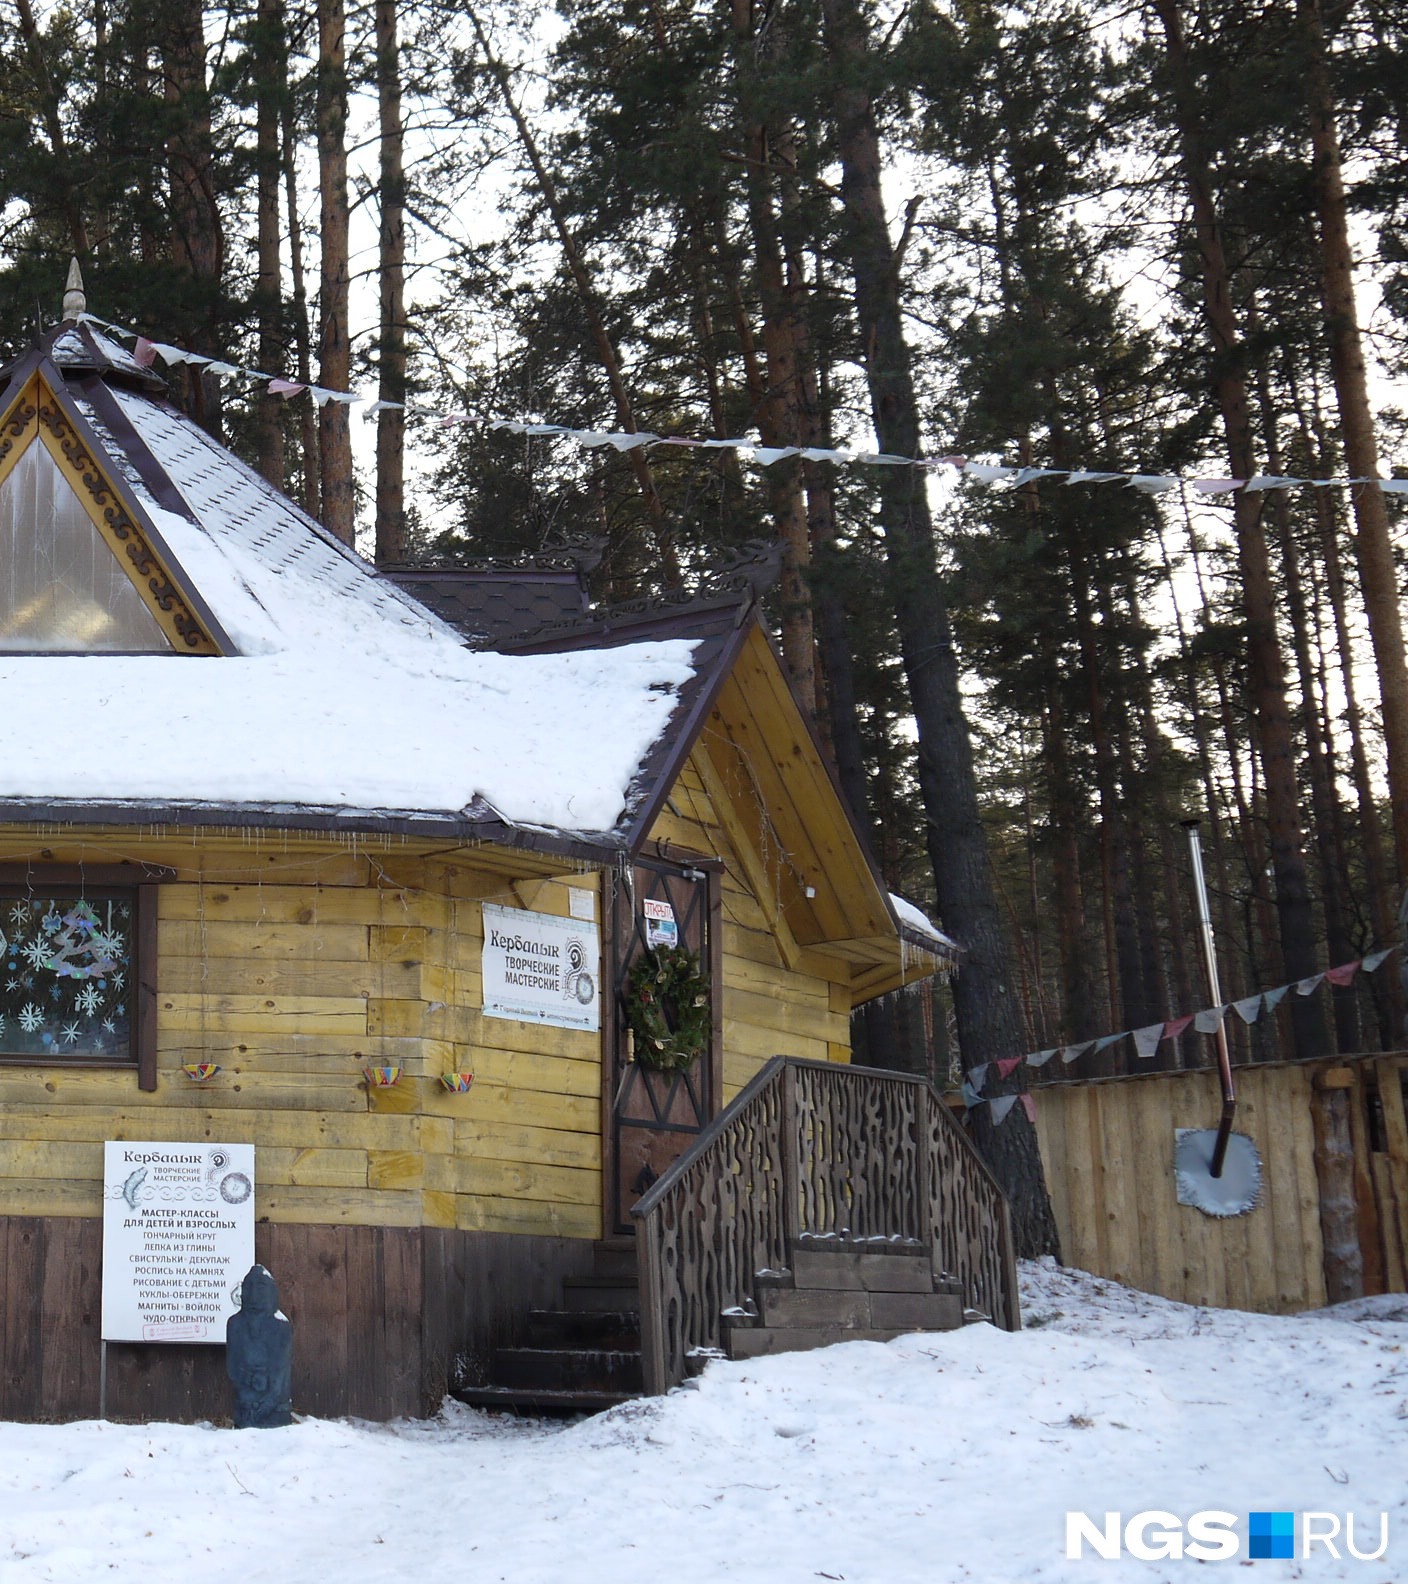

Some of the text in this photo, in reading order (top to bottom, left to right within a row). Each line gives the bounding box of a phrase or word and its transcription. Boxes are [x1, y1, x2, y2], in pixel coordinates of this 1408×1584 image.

[490, 930, 560, 958] Кербалык
[505, 956, 560, 976] ТВОРЧЕСКИЕ
[505, 972, 560, 992] МАСТЕРСКИЕ
[124, 1150, 202, 1165] Кербалык
[154, 1167, 201, 1175] ТВОРЧЕСКИЕ
[141, 1209, 219, 1218] МАСТЕР-КЛАССЫ
[124, 1218, 237, 1229] ДЛЯ ДЕТЕЙ И ВЗРОСЛЫХ
[143, 1231, 194, 1240] ГОНЧАРНЫЙ
[186, 1244, 216, 1252] ГЛИНЫ
[129, 1255, 230, 1264] СВИСТУЛЬКИ ДЕКУПАЖ
[135, 1267, 224, 1276] РОСПИСЬ НА КАМНЯХ
[133, 1279, 183, 1287] РИСОВАНИЕ
[191, 1280, 226, 1288] ДЕТЬМИ
[139, 1291, 220, 1299] КУКЛЫ-ОБЕРЕЖКИ
[138, 1302, 221, 1311] МАГНИТЫ ВОЙЛОК
[143, 1315, 216, 1324] ЧУДО-ОТКРЫТКИ
